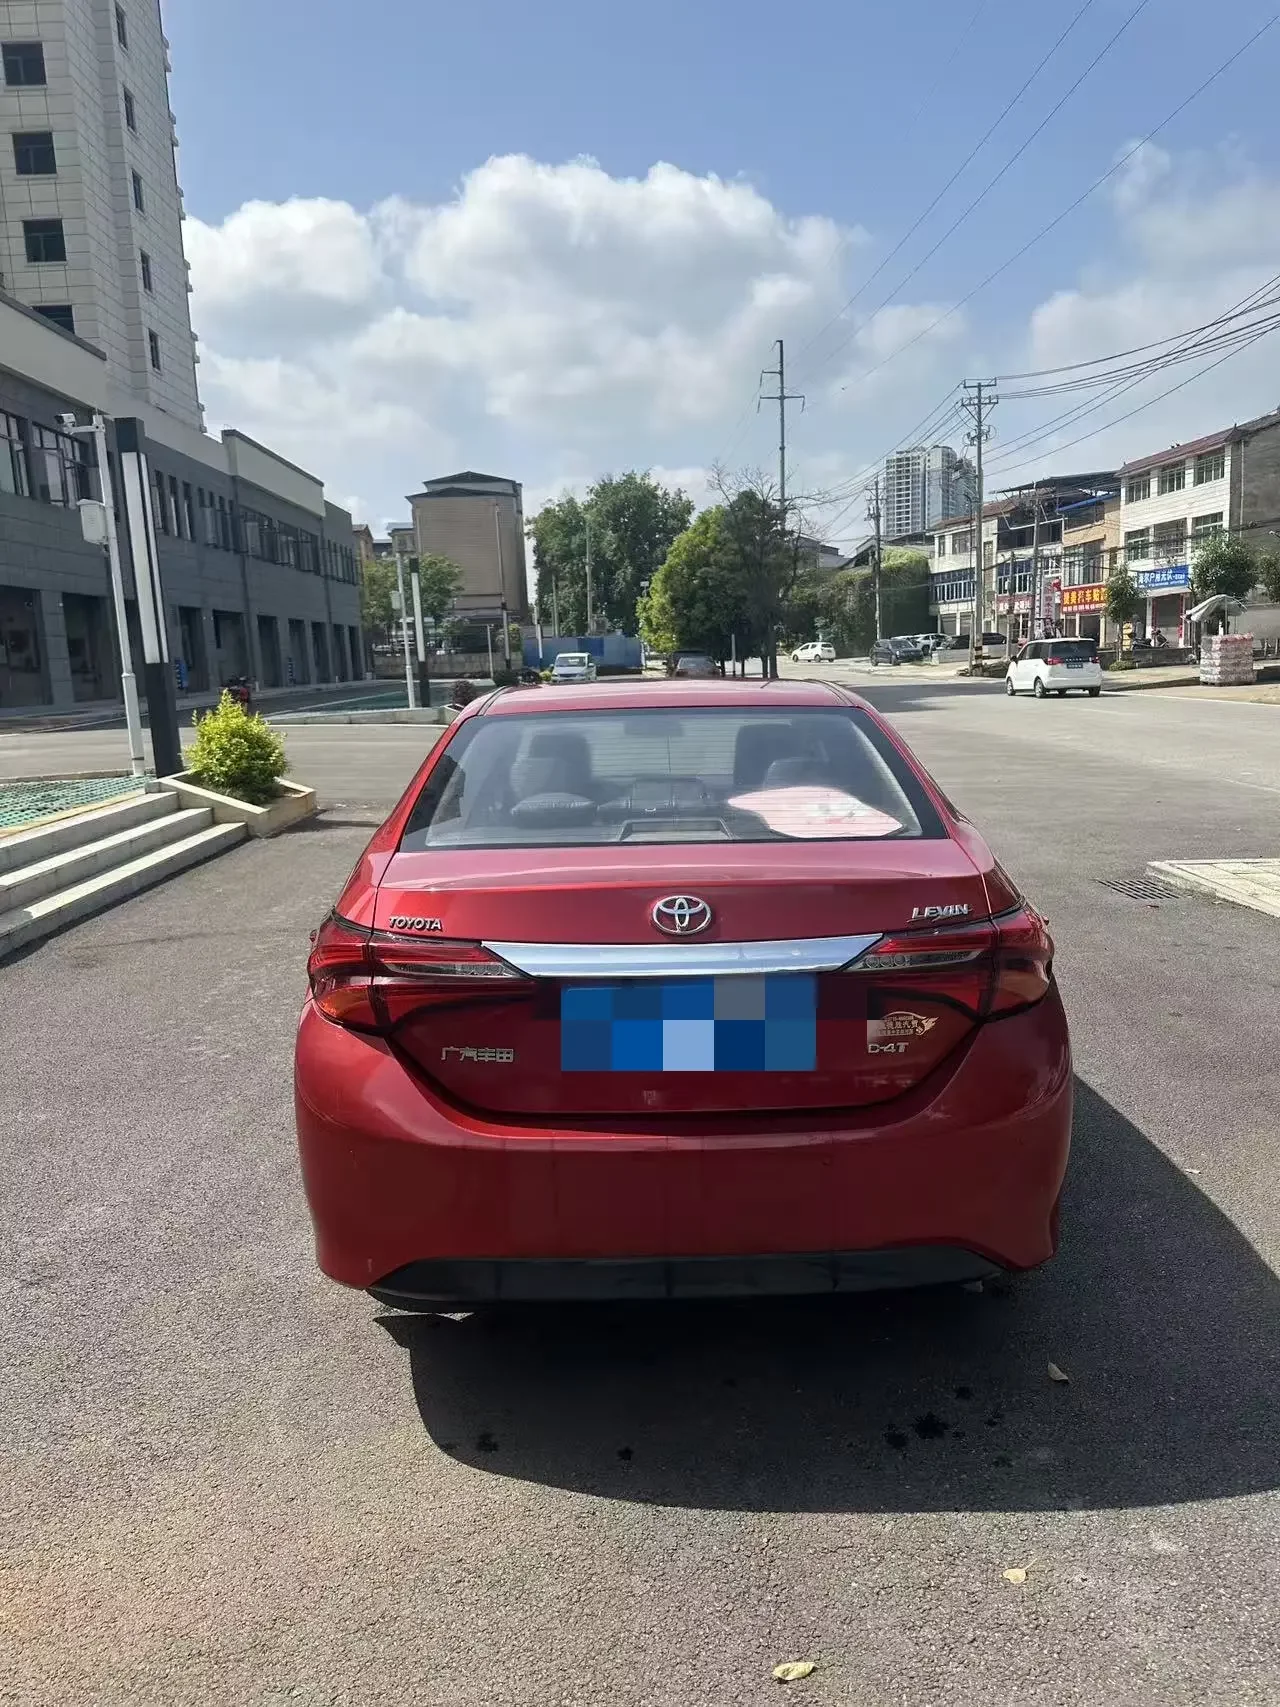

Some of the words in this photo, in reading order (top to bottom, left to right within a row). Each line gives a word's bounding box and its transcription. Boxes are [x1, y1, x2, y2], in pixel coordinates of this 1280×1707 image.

[908, 903, 970, 921] LEVIN
[389, 916, 443, 931] TOYOTA
[440, 1046, 514, 1063] 广汽丰田
[868, 1042, 909, 1054] D-4T
